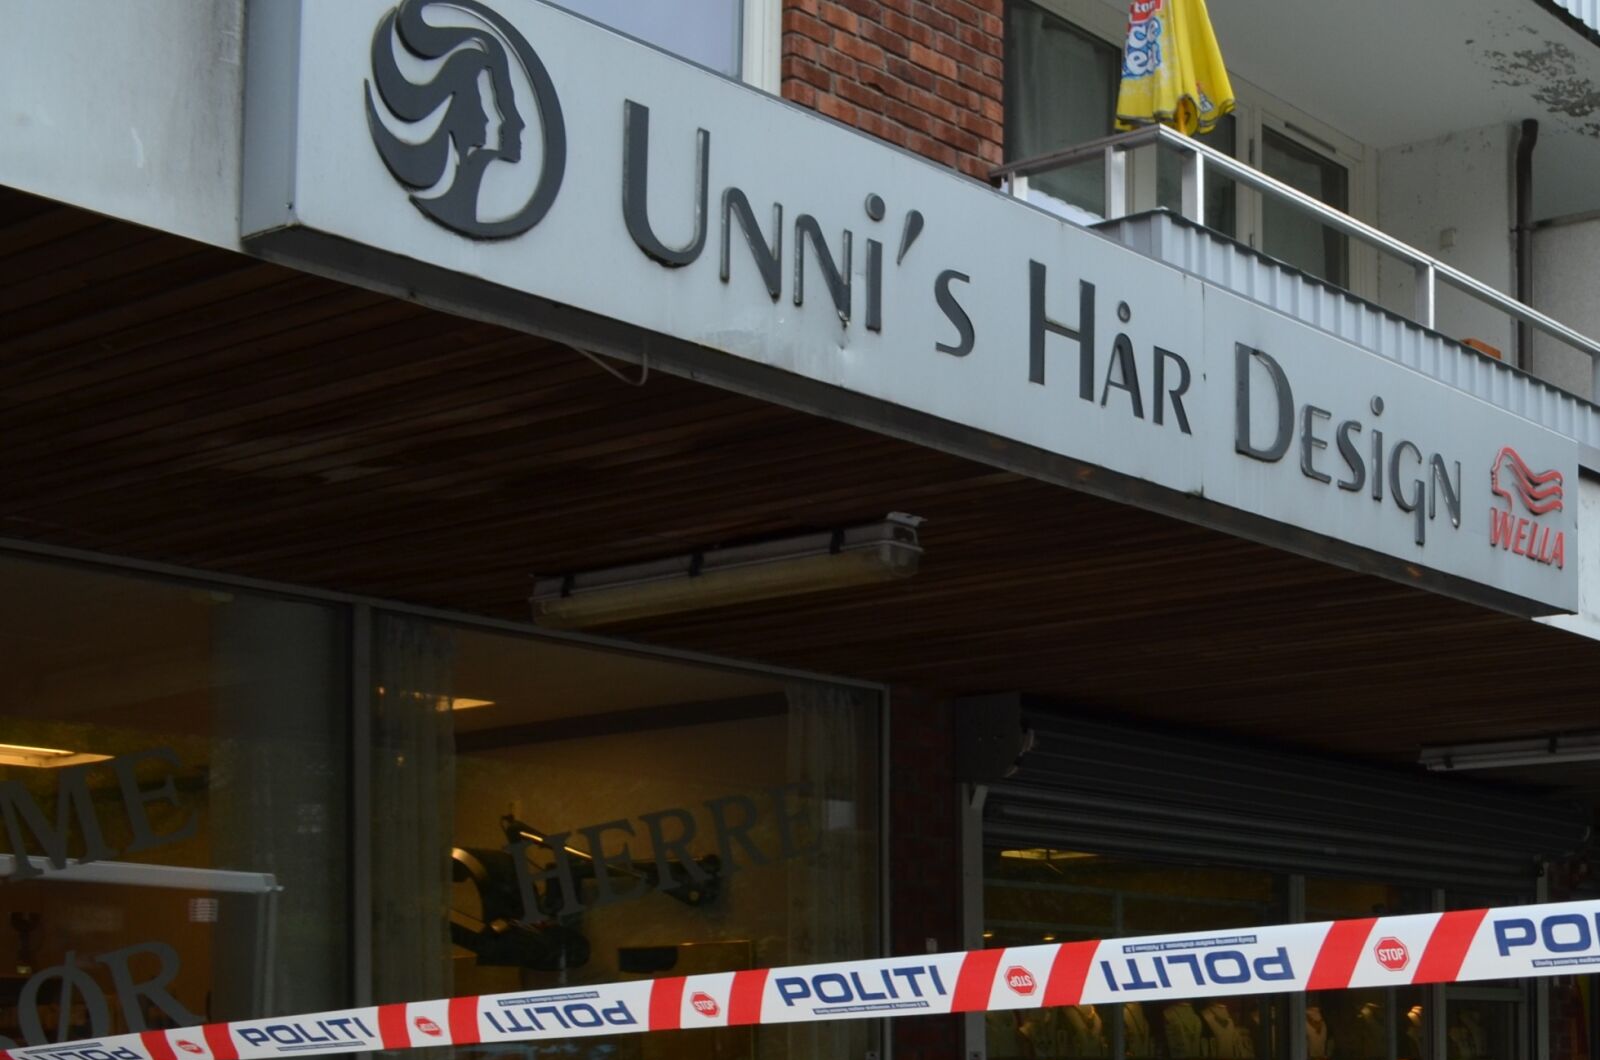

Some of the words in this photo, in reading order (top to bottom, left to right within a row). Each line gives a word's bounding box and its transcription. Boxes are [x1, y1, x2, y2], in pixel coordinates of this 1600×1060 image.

[1028, 258, 1193, 436] HÅR
[1489, 506, 1565, 571] WELLA
[508, 783, 822, 926] HERRE
[1100, 946, 1296, 992] POLITI
[1378, 947, 1405, 962] STOP
[774, 964, 948, 1007] POLITI
[1009, 975, 1033, 988] STOP
[485, 1000, 638, 1034] POLITI
[694, 998, 718, 1013] STOP
[236, 1017, 376, 1047] POLITI
